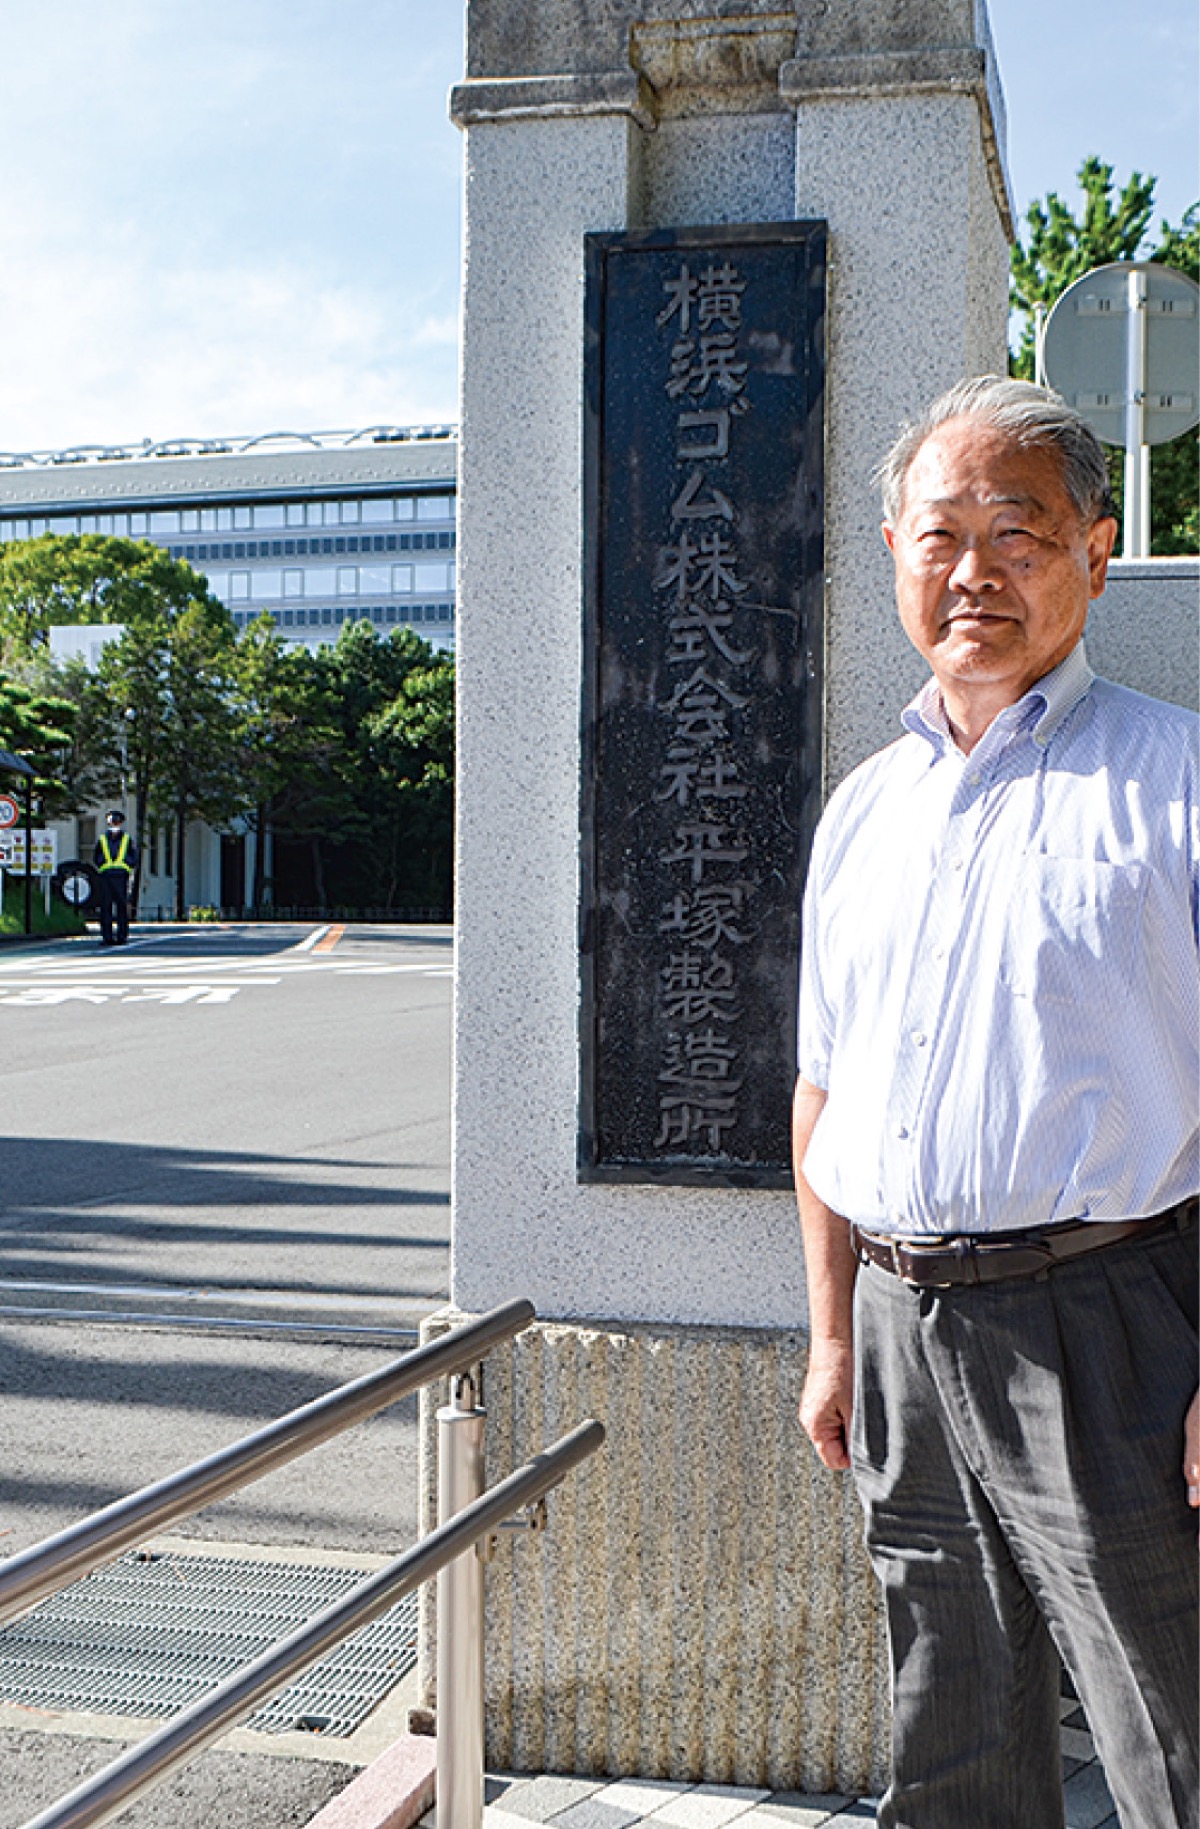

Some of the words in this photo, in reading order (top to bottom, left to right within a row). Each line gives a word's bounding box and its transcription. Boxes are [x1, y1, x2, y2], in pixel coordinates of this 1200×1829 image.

[653, 262, 755, 1150] 横浜ゴム株式会社平塚製造所
